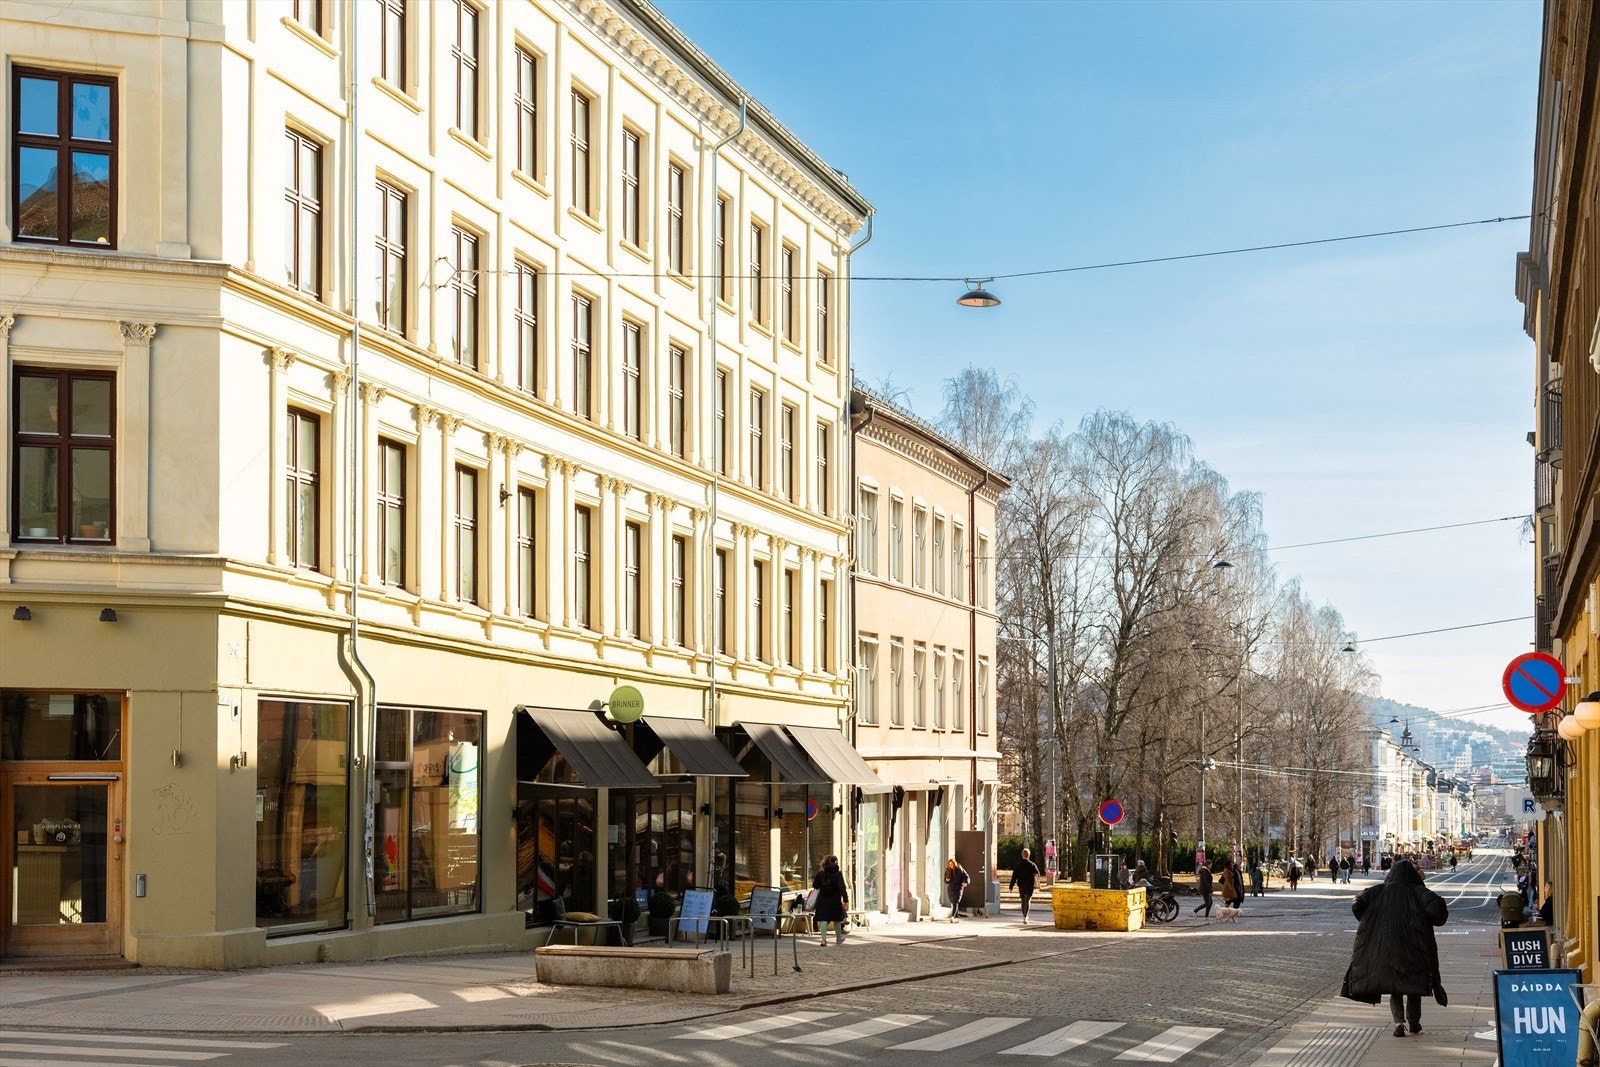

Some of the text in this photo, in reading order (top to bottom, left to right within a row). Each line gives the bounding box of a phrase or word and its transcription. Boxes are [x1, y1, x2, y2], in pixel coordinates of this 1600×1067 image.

[1524, 799, 1535, 812] R
[1511, 940, 1541, 951] LUSH
[1513, 954, 1542, 965] DIVE
[1511, 980, 1563, 992] DÁIDDA
[1513, 1006, 1567, 1034] HUN
